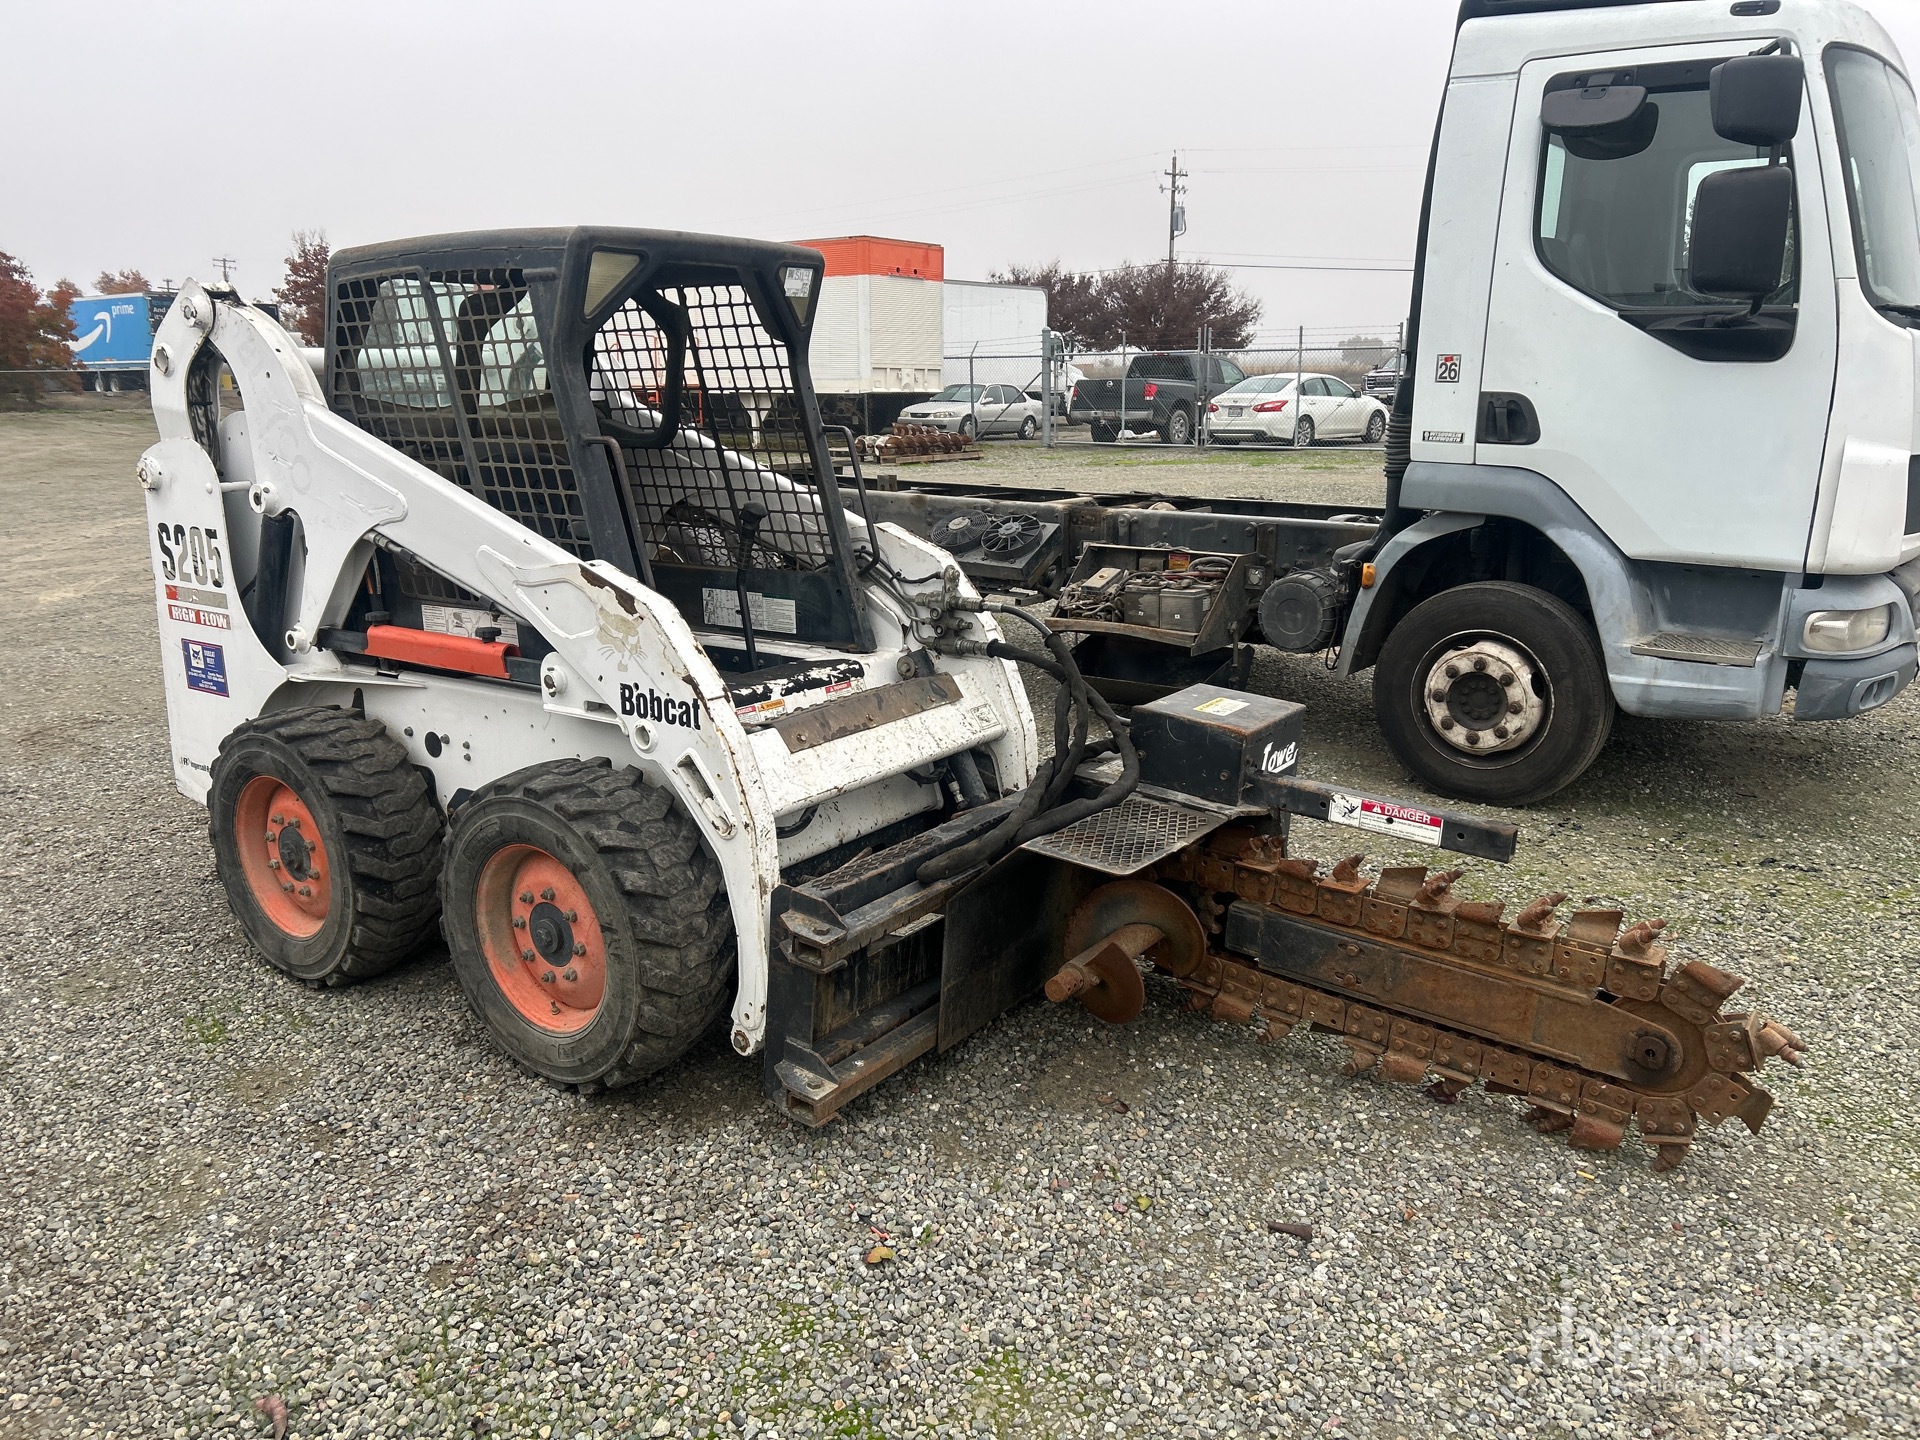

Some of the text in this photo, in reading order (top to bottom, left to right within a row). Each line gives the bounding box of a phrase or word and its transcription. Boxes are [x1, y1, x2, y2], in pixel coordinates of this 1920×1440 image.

[111, 302, 134, 318] prime
[1438, 362, 1458, 381] 26
[157, 522, 224, 589] S205
[171, 606, 227, 629] HIGH FLOW
[620, 683, 701, 730] Bobcat
[1384, 806, 1431, 824] DANGER
